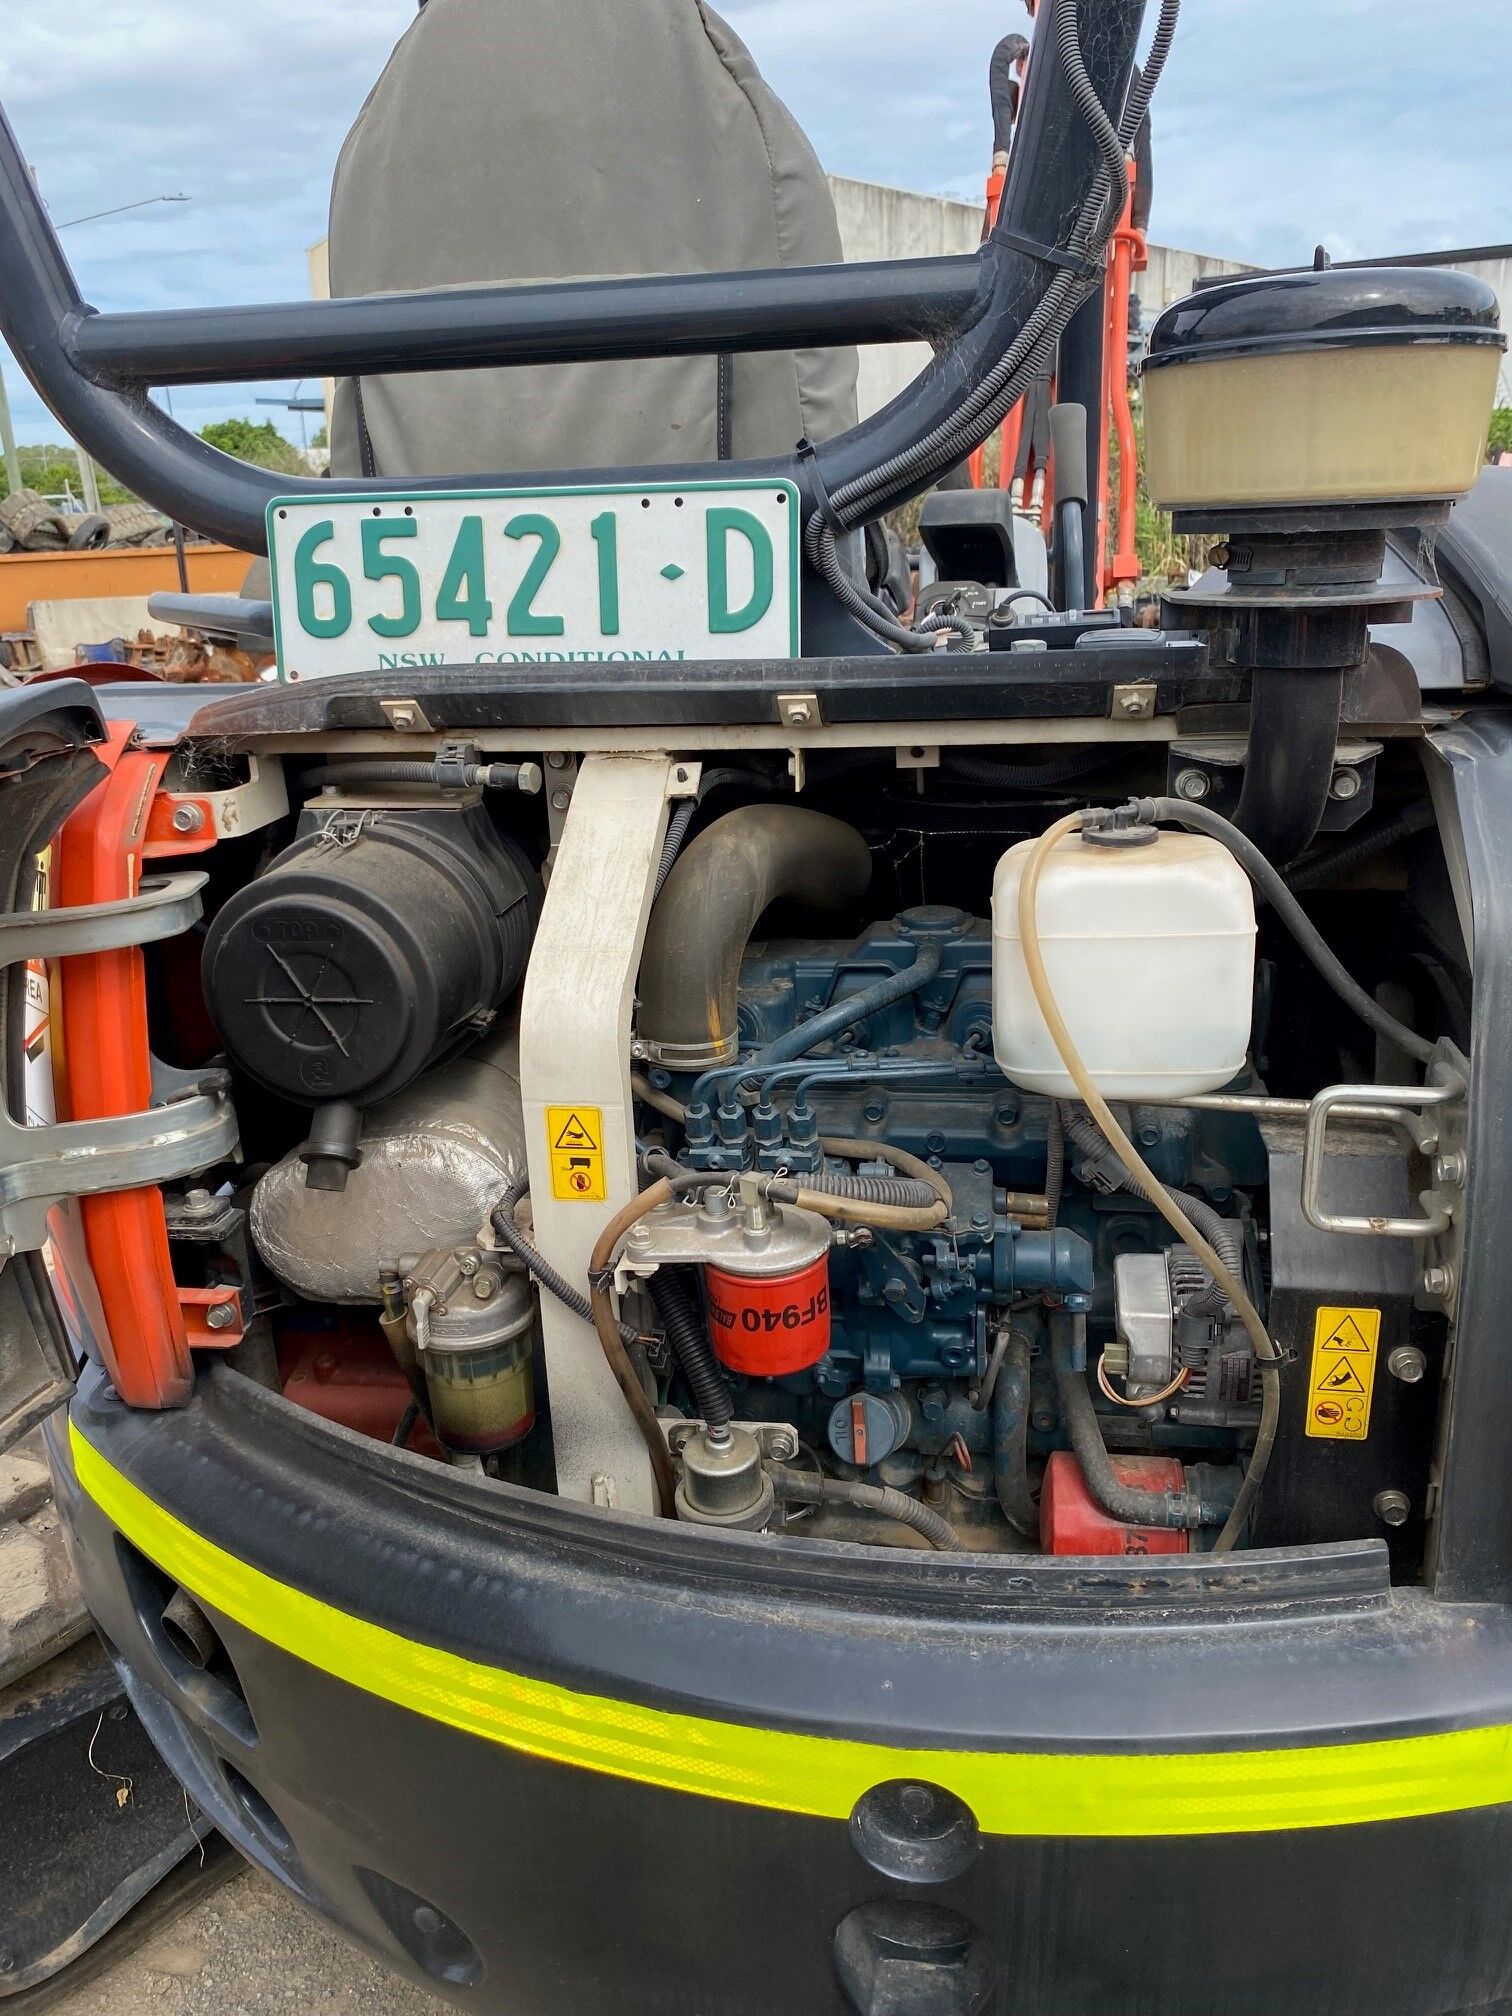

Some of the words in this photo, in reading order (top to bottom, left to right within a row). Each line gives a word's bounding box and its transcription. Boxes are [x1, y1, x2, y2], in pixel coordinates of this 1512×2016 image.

[378, 653, 445, 669] NSW
[741, 1284, 828, 1332] BF940
[834, 1419, 848, 1445] OIL
